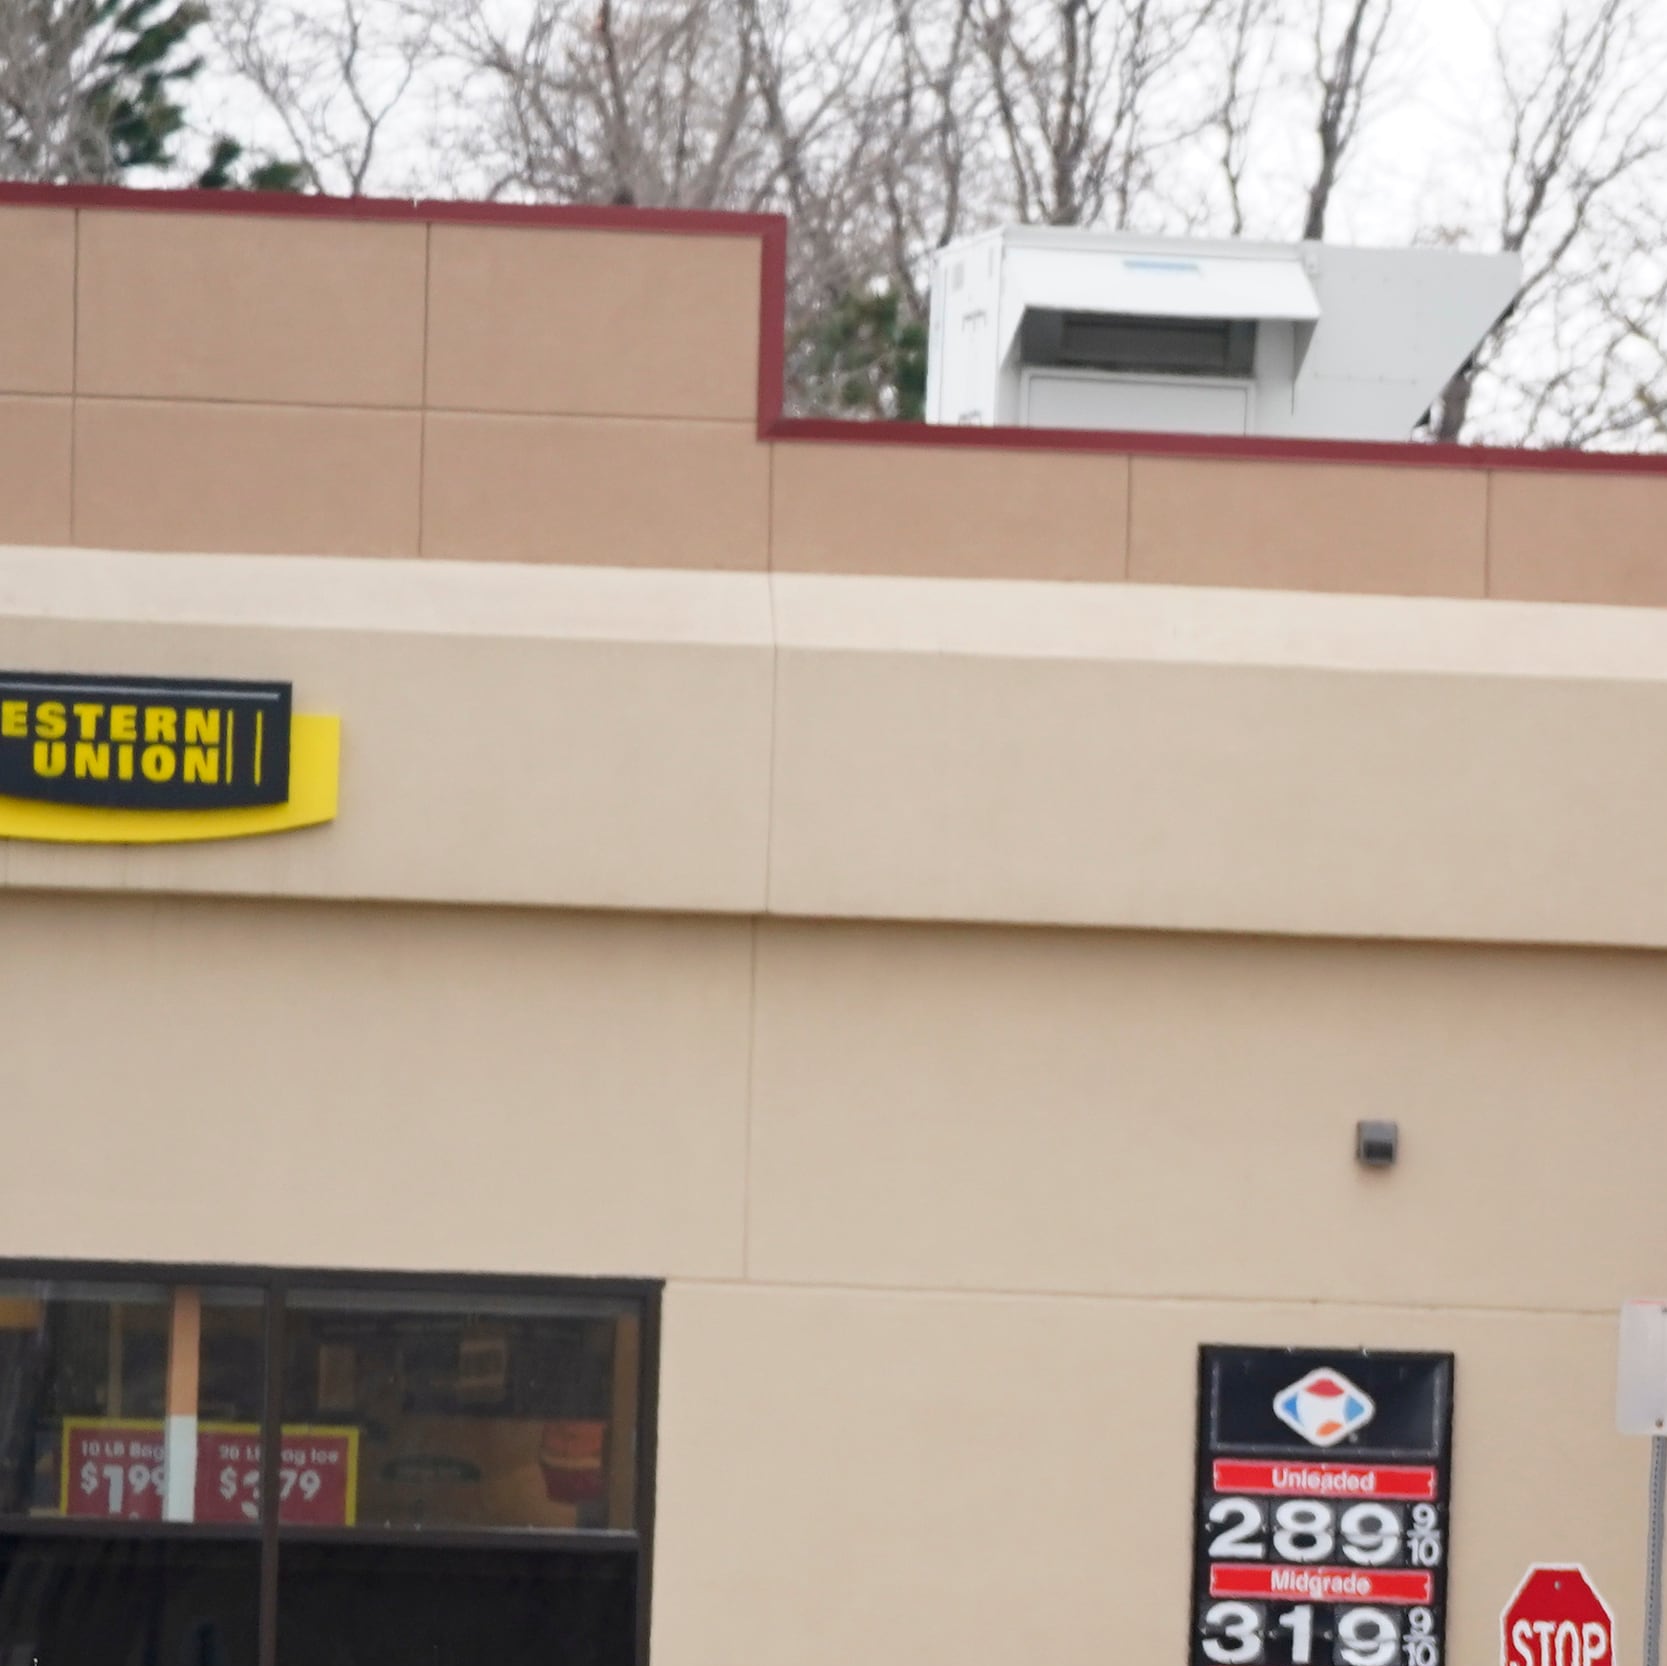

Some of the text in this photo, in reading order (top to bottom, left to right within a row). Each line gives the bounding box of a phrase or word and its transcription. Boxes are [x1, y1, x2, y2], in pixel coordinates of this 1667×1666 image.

[0, 700, 221, 744] ESTERN
[33, 740, 220, 784] UNION
[1272, 1468, 1375, 1493] Unleaded
[1207, 1497, 1402, 1566] 289
[1270, 1569, 1372, 1600] Midgrade
